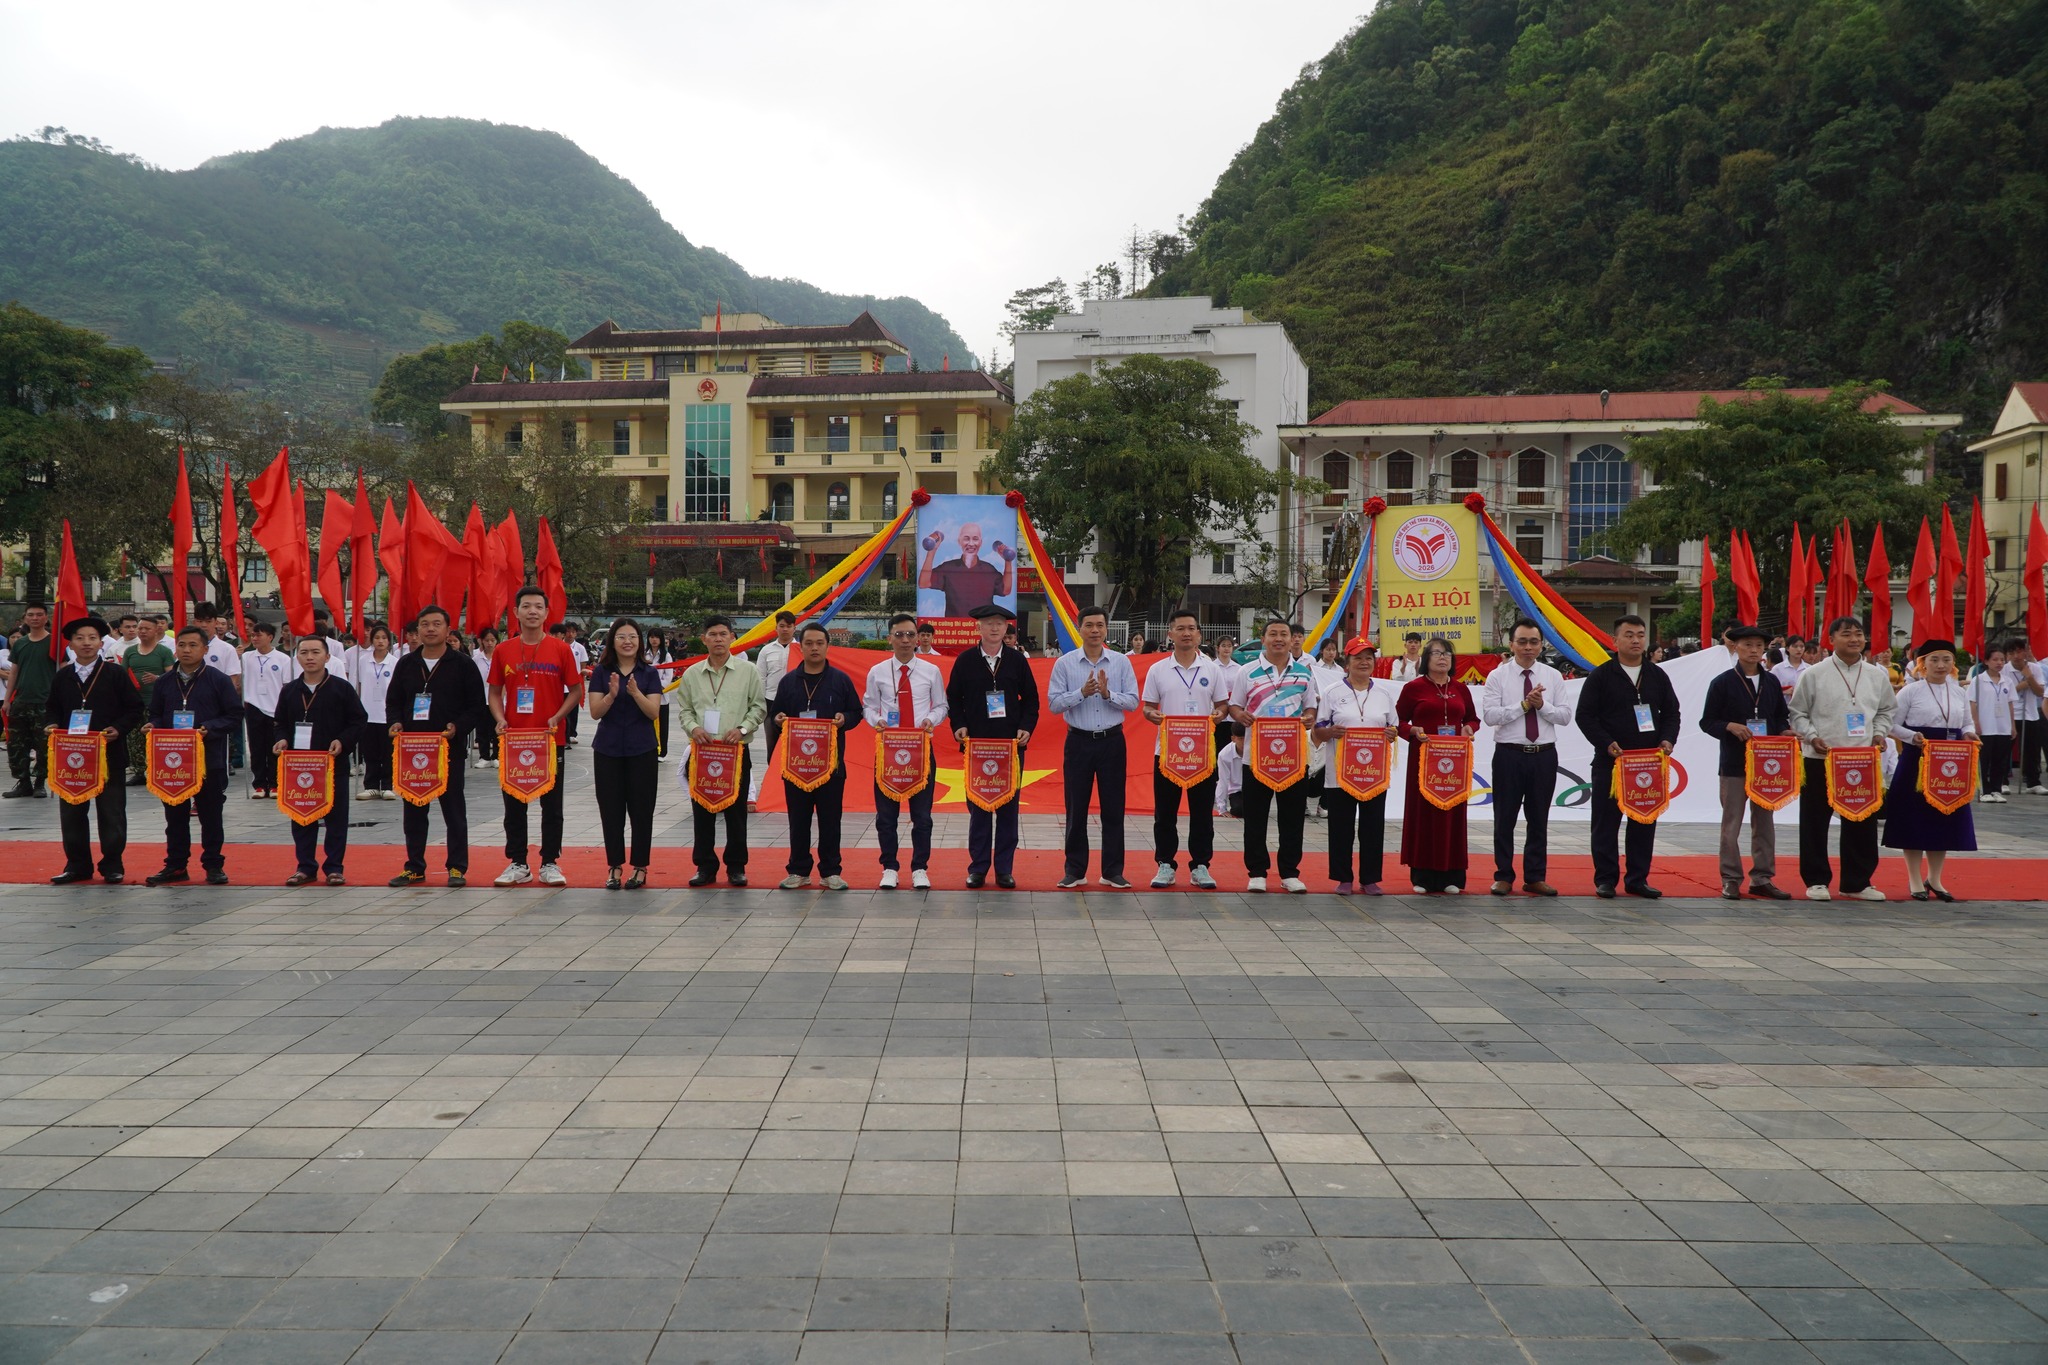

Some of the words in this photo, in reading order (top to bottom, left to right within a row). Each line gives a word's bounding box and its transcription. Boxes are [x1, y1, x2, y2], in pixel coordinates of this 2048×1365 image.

[1020, 580, 1027, 588] XÃ
[1388, 594, 1425, 611] ĐẠI
[1432, 587, 1471, 610] HỘI
[1386, 616, 1397, 627] THỂ
[1398, 618, 1410, 628] DỤC
[1412, 615, 1422, 626] THỂ
[1424, 618, 1438, 626] THAO
[1441, 616, 1448, 625] XÃ
[1465, 616, 1476, 626] VẠC
[1447, 631, 1461, 639] 2026
[1294, 676, 1298, 684] 7
